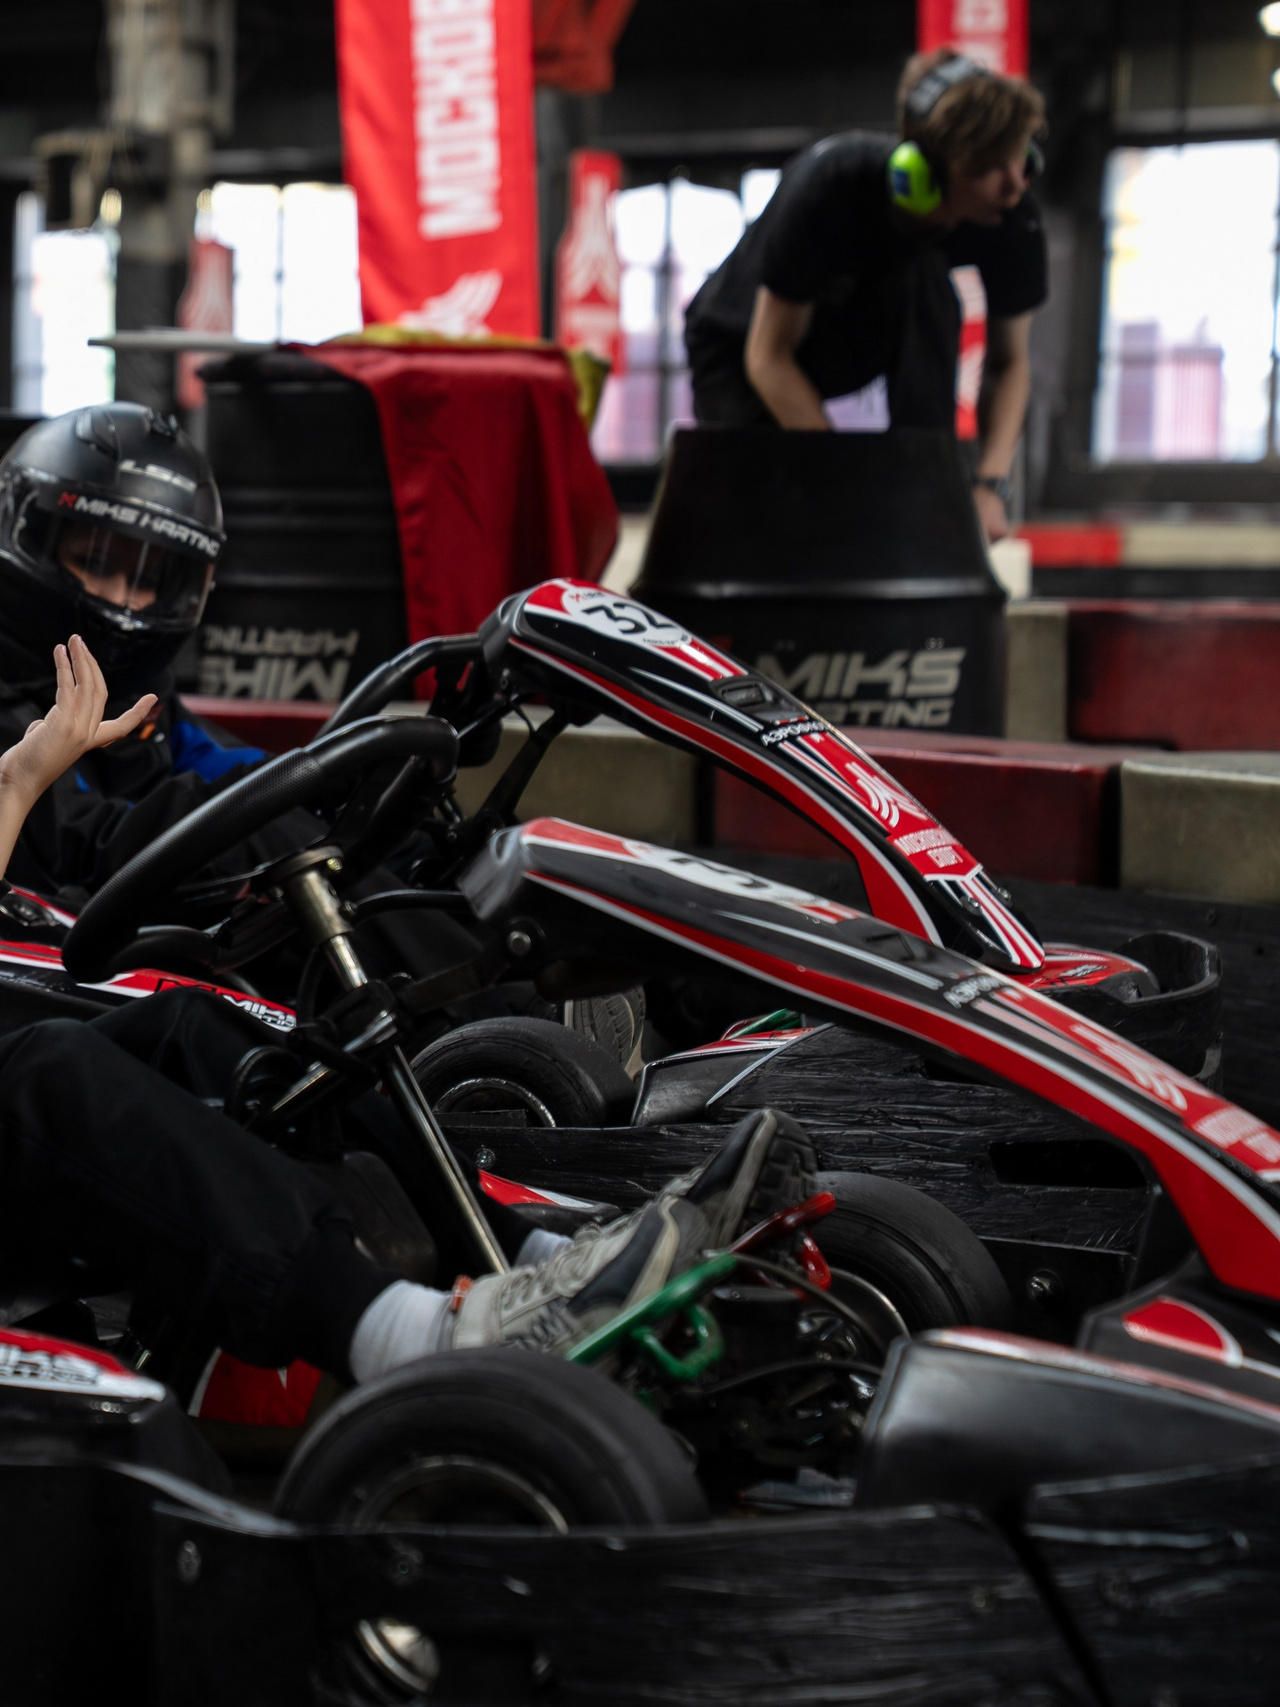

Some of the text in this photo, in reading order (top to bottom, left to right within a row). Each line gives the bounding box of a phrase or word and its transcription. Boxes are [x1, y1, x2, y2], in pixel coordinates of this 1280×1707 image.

[74, 495, 221, 558] MIKS KARTING
[581, 602, 678, 634] 32
[755, 648, 966, 698] MIKS
[814, 700, 952, 727] RTING
